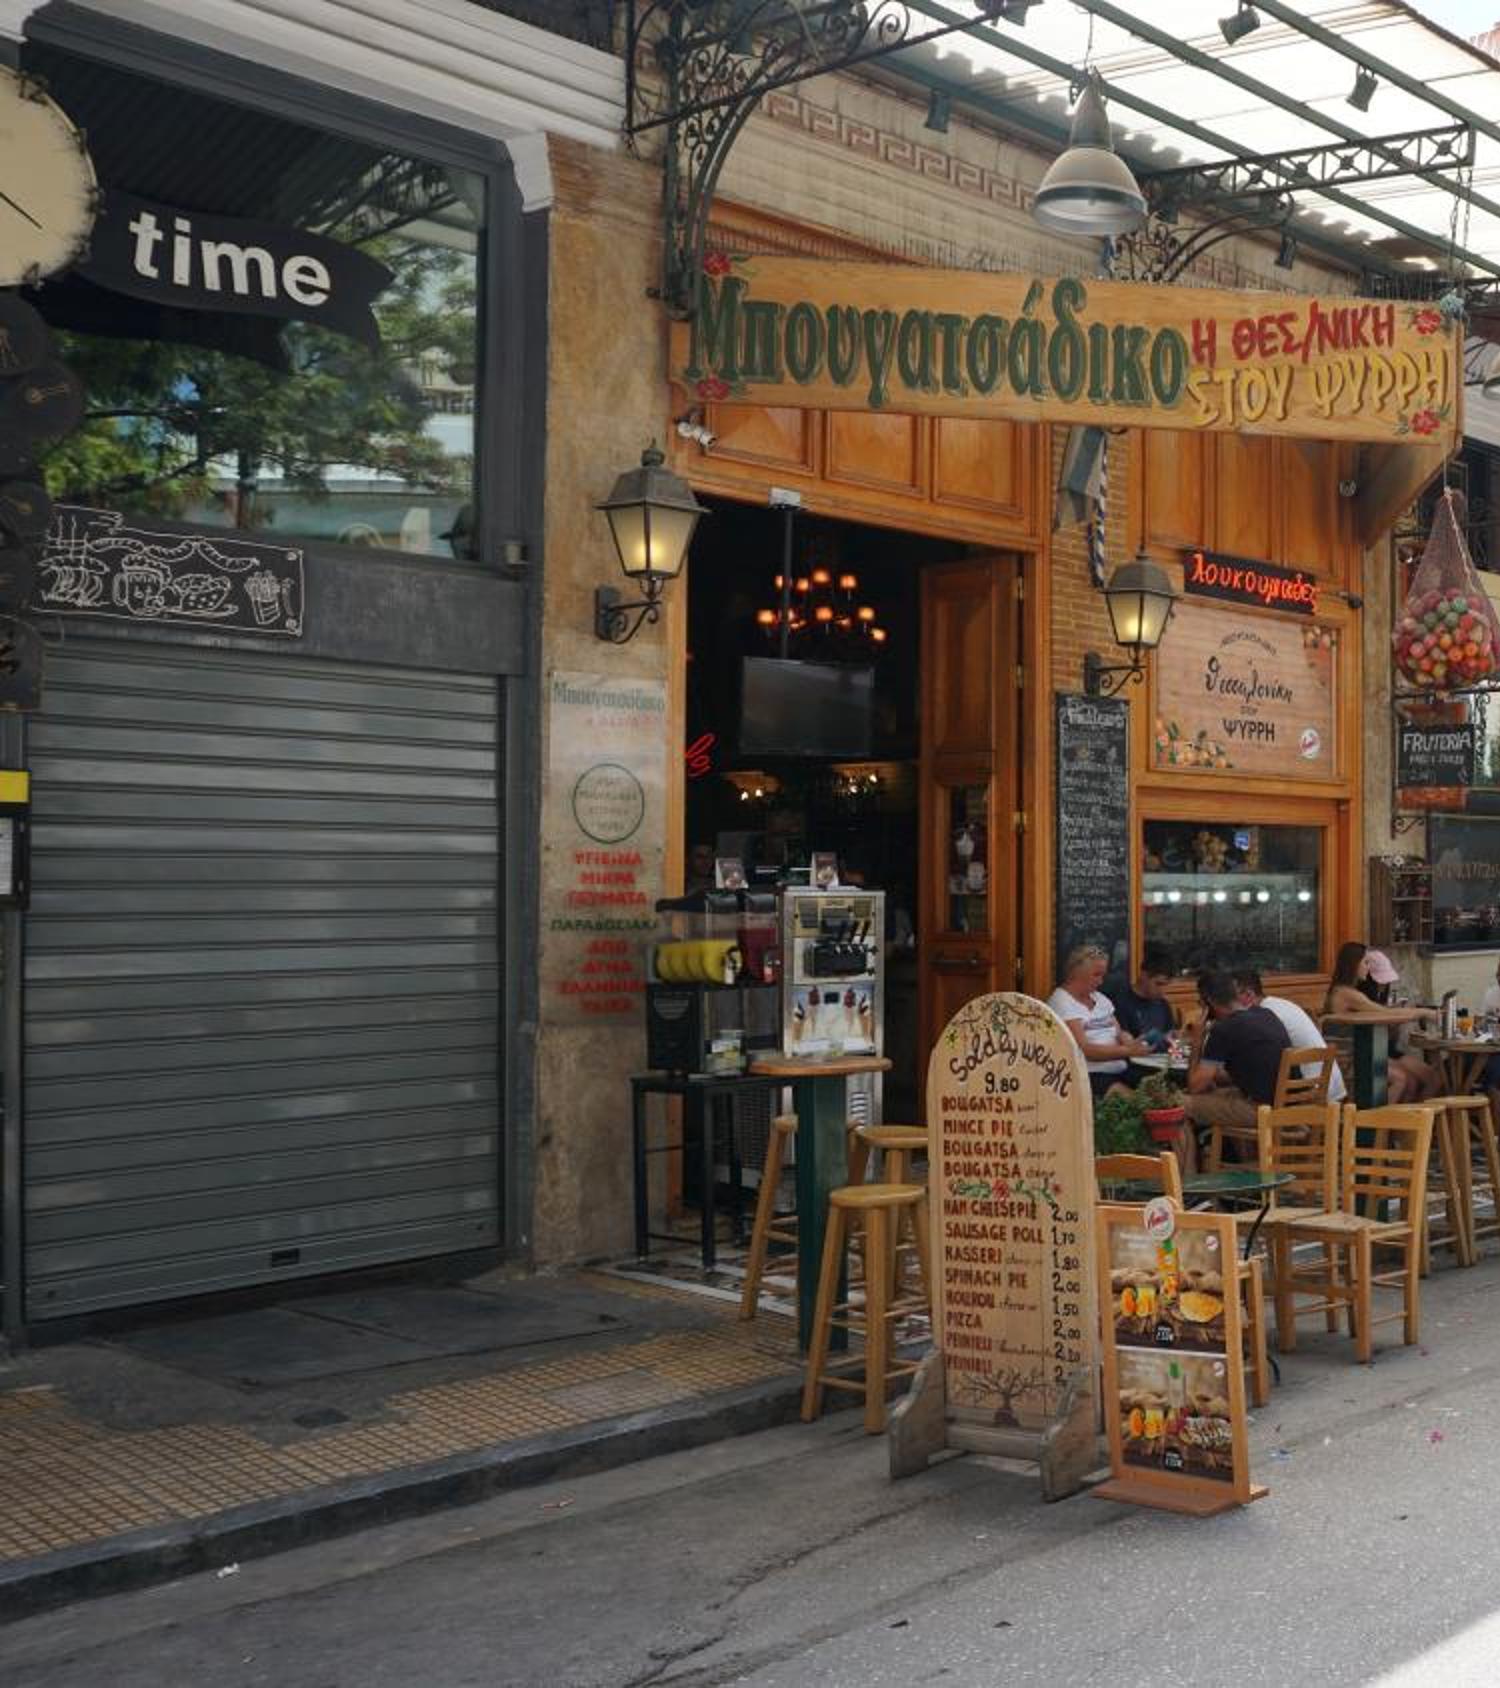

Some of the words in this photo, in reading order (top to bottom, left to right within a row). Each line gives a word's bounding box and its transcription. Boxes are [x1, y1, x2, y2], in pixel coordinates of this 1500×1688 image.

[129, 211, 331, 306] time
[683, 276, 1190, 410] Μπουγατσάδικο
[950, 1028, 994, 1082] Sold
[1021, 1034, 1073, 1098] weight
[942, 1096, 1014, 1114] BOUGATSA
[944, 1119, 985, 1136] MINCE
[991, 1119, 1014, 1138] PIE
[944, 1139, 1018, 1159] BOUGATSA
[944, 1161, 1021, 1178] BOUGATSA
[945, 1221, 1007, 1242] SAUSAGE
[945, 1245, 1002, 1265] KASSERI
